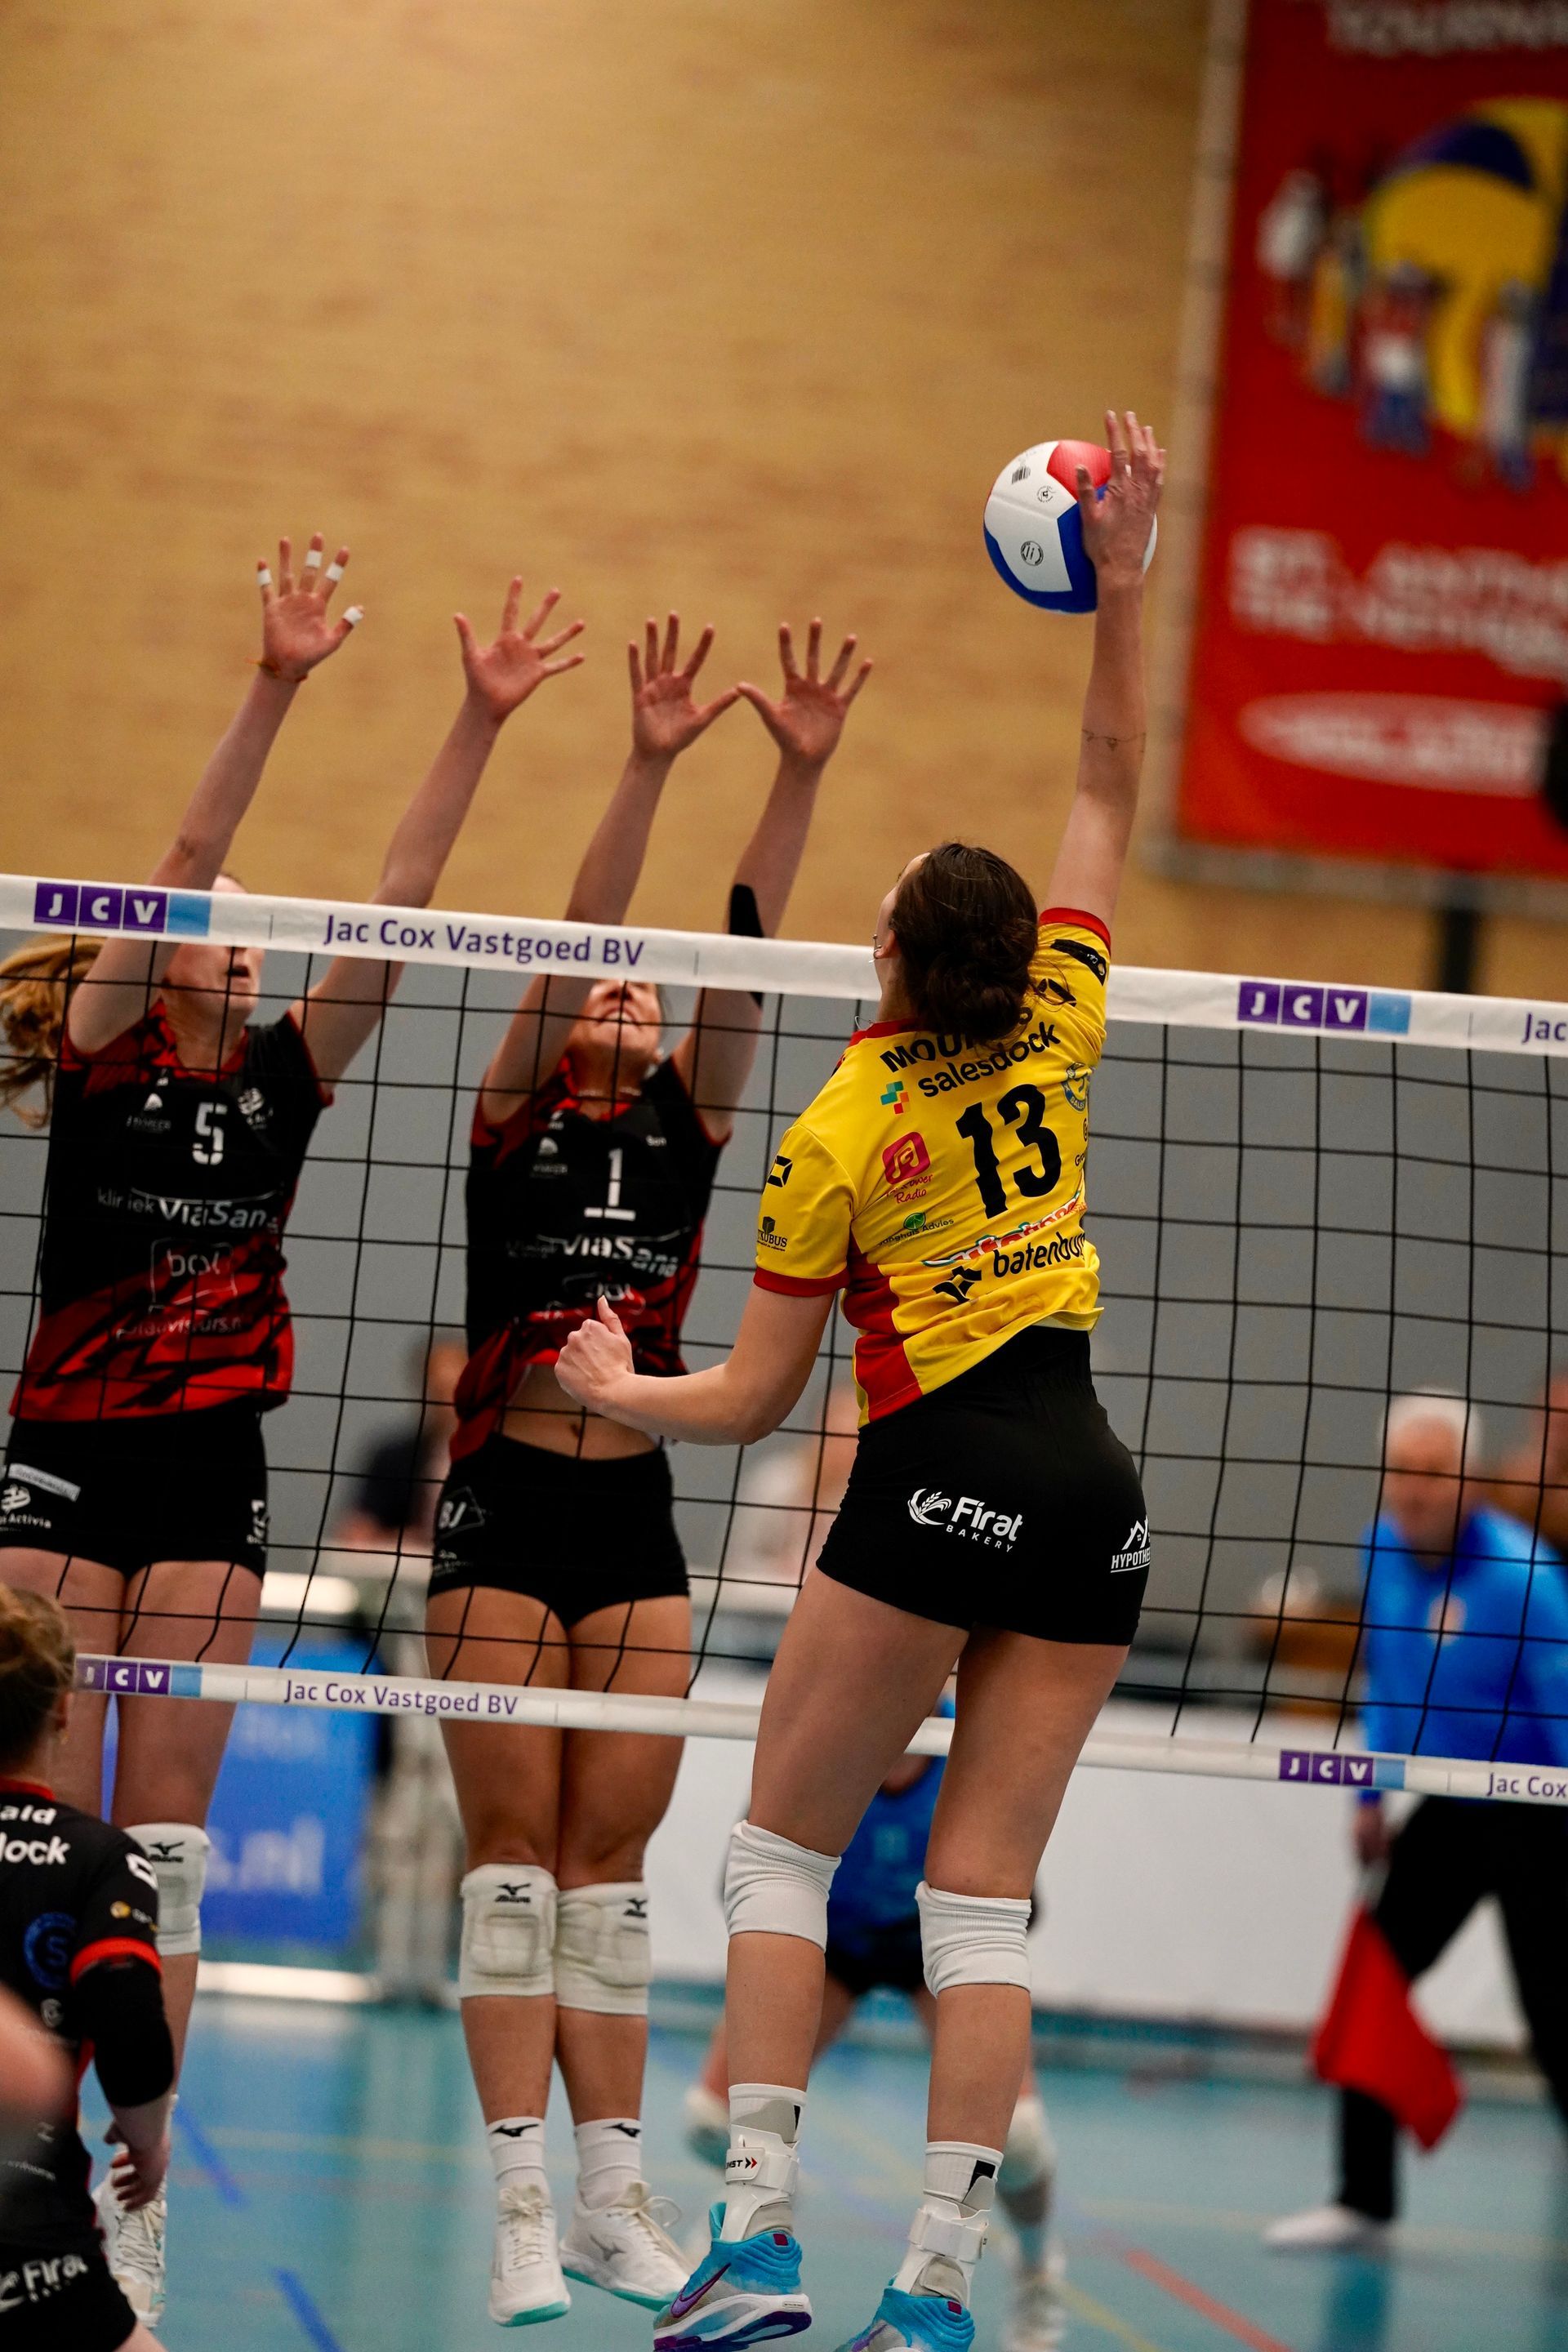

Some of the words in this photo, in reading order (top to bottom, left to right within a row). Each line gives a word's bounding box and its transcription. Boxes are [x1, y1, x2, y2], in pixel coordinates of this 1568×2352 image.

[48, 893, 158, 924] JCV
[323, 914, 369, 946] Jac
[380, 919, 435, 949] Cox
[446, 924, 591, 964] Vastgoed
[603, 938, 644, 966] BV
[1250, 991, 1361, 1024] JCV
[1521, 1012, 1567, 1044] Jac
[918, 1021, 1062, 1098] salesdock
[192, 1102, 229, 1165] 5
[955, 1084, 1062, 1219] 13
[584, 1147, 637, 1222] 1
[894, 1188, 927, 1204] Radio
[951, 1496, 1023, 1542] Firat
[946, 1524, 1013, 1552] BAKERY
[86, 1666, 164, 1689] JCV
[283, 1679, 318, 1703] Jac
[326, 1682, 366, 1704] Cox
[373, 1686, 479, 1715] Vastgoed
[488, 1695, 519, 1715] BV
[1288, 1757, 1370, 1781] JCV
[1486, 1772, 1520, 1797] Jac
[1527, 1775, 1567, 1798] Cox
